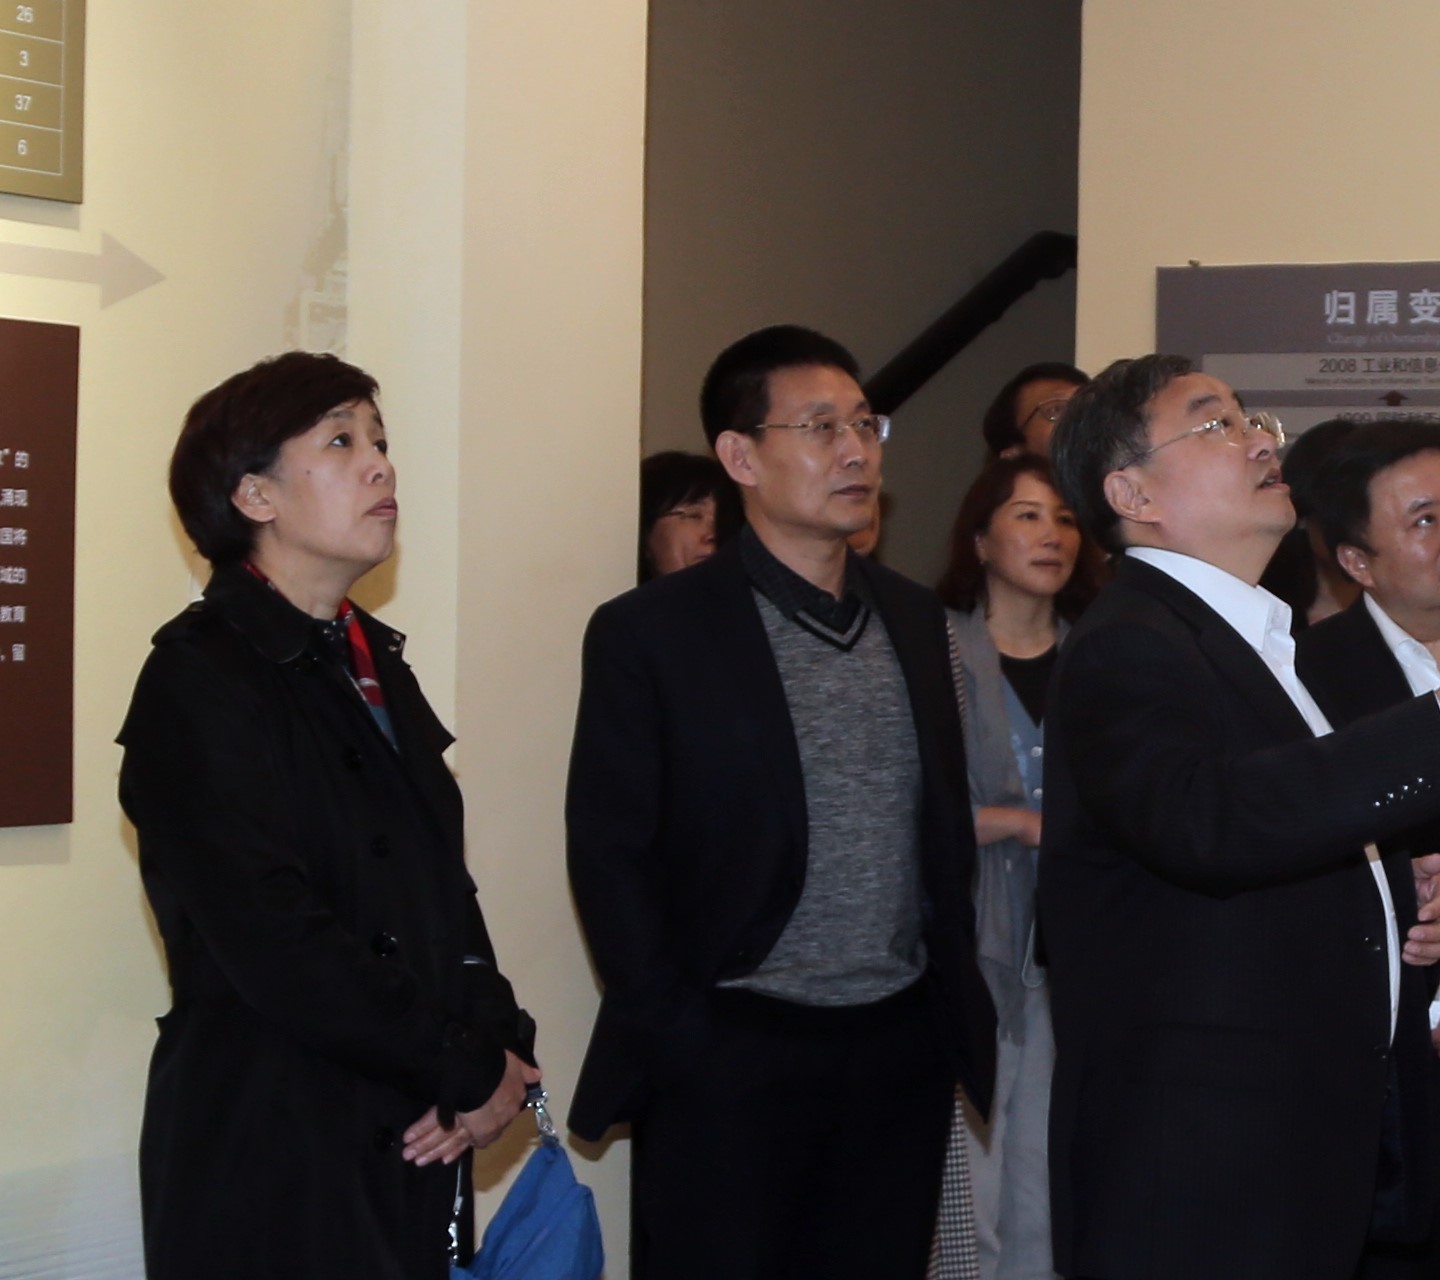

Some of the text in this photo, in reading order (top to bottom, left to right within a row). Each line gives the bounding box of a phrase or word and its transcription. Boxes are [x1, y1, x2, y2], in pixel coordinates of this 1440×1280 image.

[16, 5, 35, 24] 26
[19, 50, 30, 68] 3
[15, 95, 32, 113] 37
[17, 138, 28, 157] 6
[1319, 357, 1357, 374] 2008
